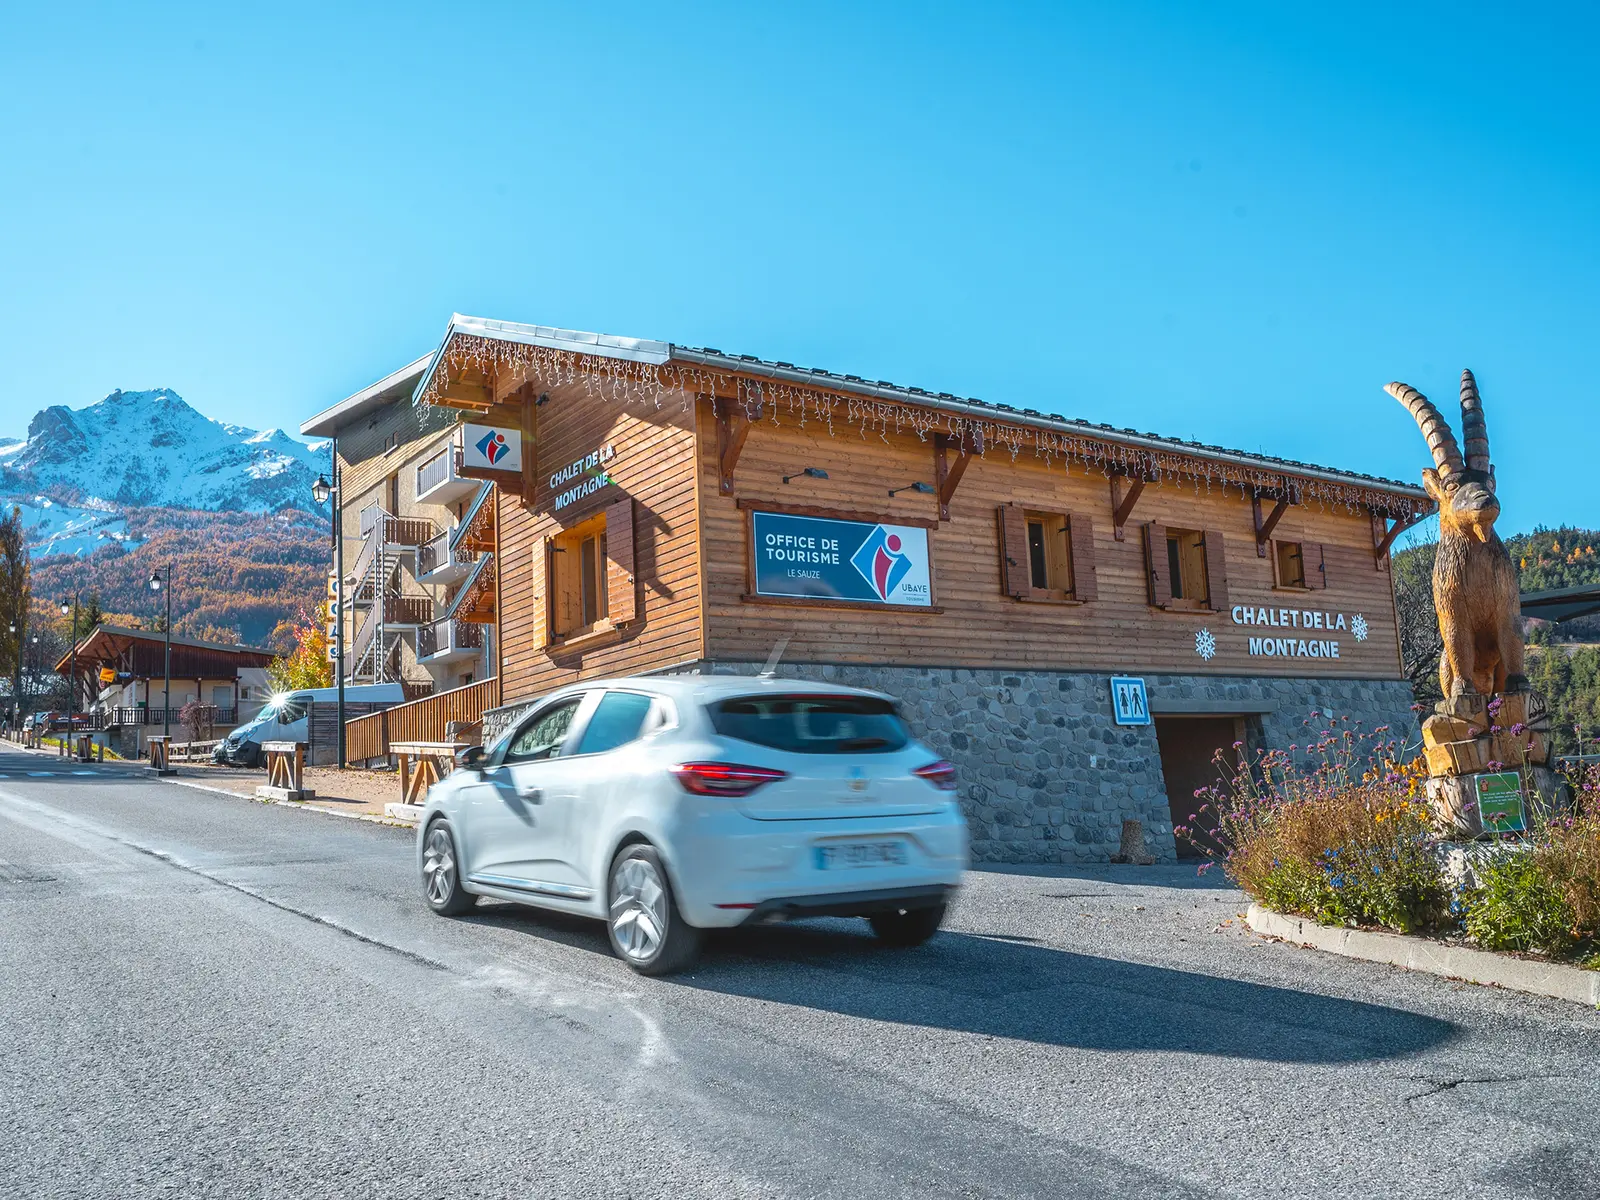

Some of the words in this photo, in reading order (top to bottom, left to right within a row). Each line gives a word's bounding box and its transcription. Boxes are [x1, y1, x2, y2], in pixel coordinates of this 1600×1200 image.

[550, 460, 584, 488] CHALET
[585, 450, 599, 470] DE
[599, 443, 614, 463] LA
[555, 472, 607, 511] MONTAGNE
[765, 533, 816, 549] OFFICE
[821, 538, 839, 551] DE
[765, 548, 840, 565] TOURISME
[787, 568, 796, 578] LE
[797, 569, 821, 579] SAUZE
[901, 583, 928, 593] UBAYE
[1231, 606, 1299, 626] CHALET
[1302, 611, 1323, 629] DE
[1325, 613, 1347, 631] LA
[1249, 638, 1339, 658] MONTAGNE
